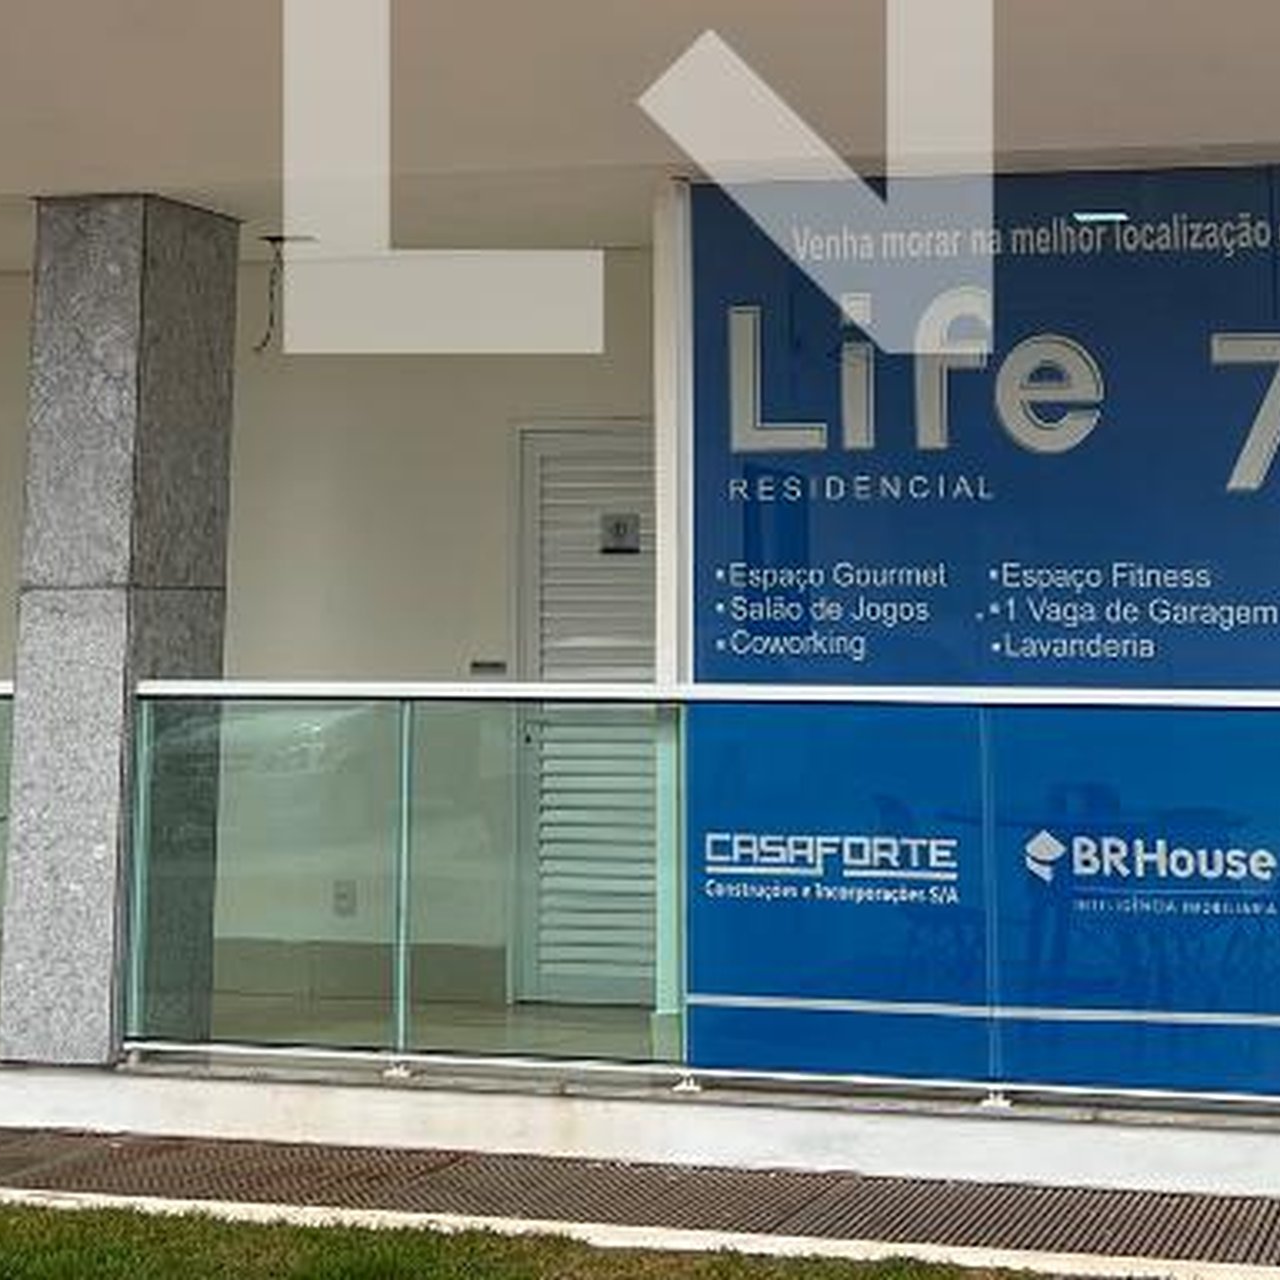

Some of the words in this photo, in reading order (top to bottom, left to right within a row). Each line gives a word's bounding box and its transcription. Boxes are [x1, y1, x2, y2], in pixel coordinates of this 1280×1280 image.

[792, 222, 874, 261] Venha
[881, 227, 963, 259] morar
[970, 229, 1002, 255] na
[1011, 215, 1107, 256] melhor
[1115, 212, 1271, 258] localização
[727, 286, 1106, 455] Life
[727, 474, 994, 502] RESIDENCIAL
[728, 562, 824, 594] Espaço
[831, 562, 949, 588] Gourmet
[1001, 562, 1103, 594] Espaço
[1111, 562, 1212, 589] Fitness
[729, 595, 804, 622] Salão
[808, 597, 844, 622] de
[850, 596, 932, 628] Jogos
[1006, 597, 1017, 621] 1
[1025, 598, 1096, 628] Vaga
[1104, 597, 1140, 623] de
[1148, 598, 1280, 631] Garagem
[729, 629, 867, 662] Coworking
[1004, 632, 1156, 659] Lavanderia
[705, 832, 959, 870] CASAFORTE
